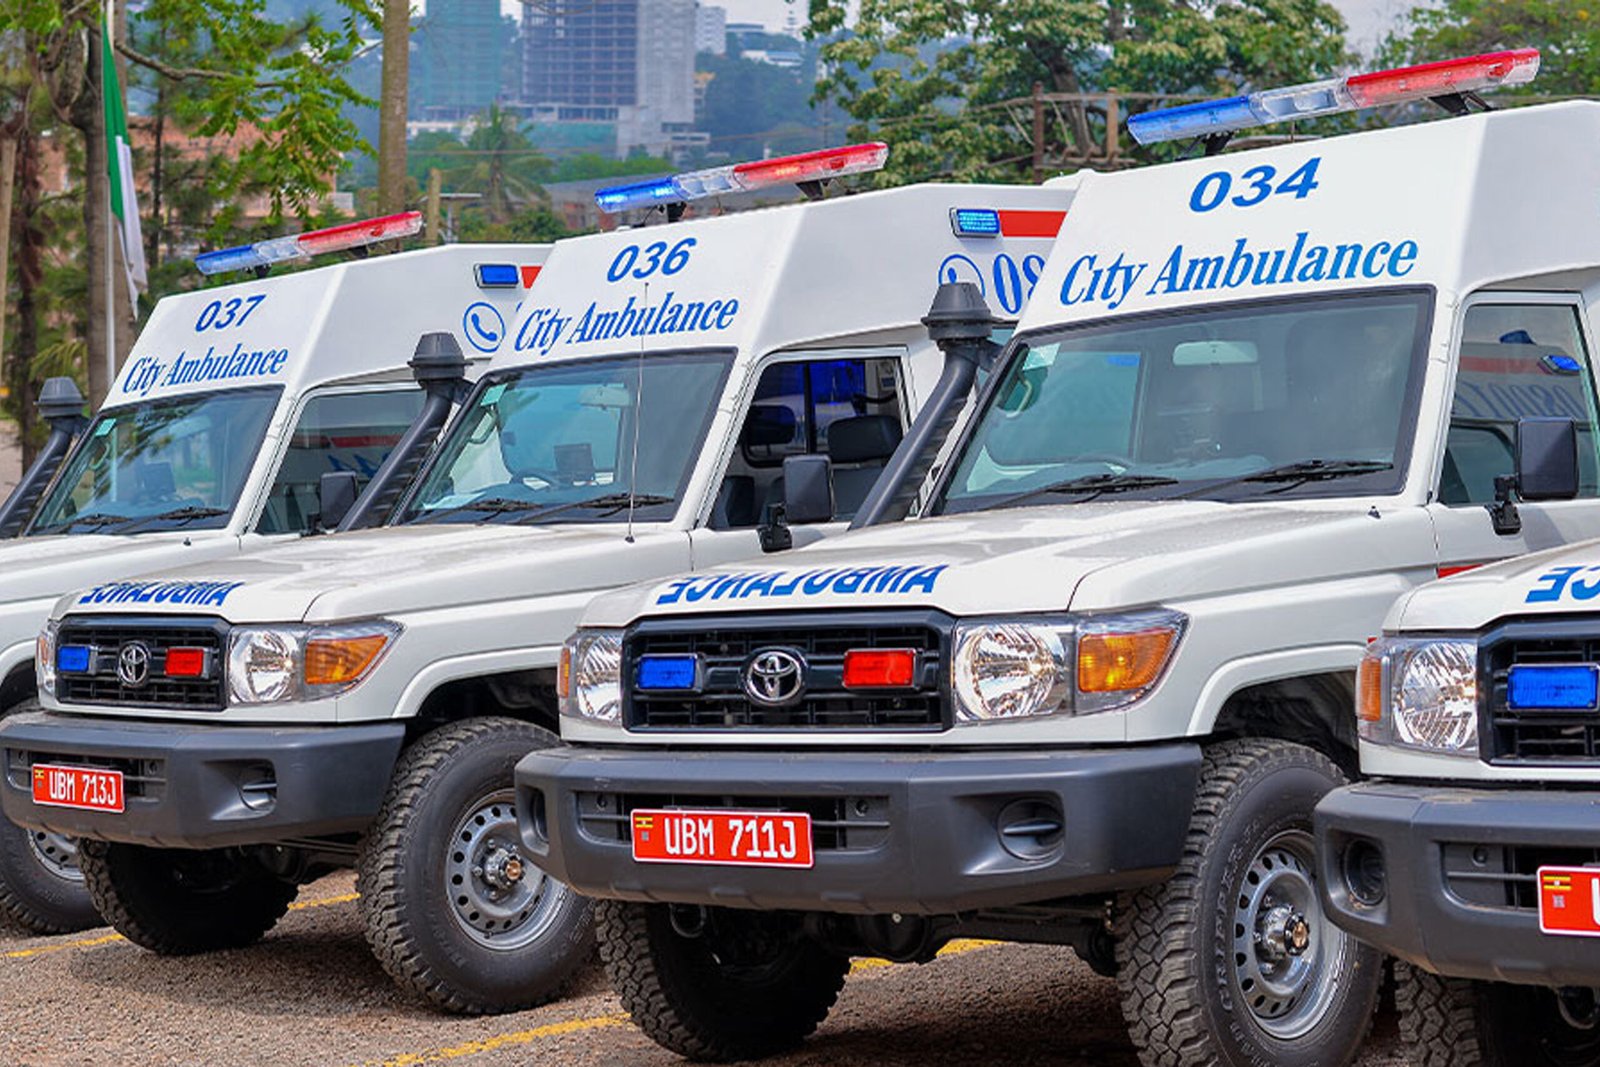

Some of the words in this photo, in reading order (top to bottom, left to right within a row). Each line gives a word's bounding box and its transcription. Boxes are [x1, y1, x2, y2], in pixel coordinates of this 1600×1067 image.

[1189, 157, 1322, 214] 034
[606, 237, 697, 282] 036
[1146, 232, 1418, 297] Ambulance
[195, 294, 266, 333] 037
[513, 307, 565, 357] City
[566, 292, 739, 345] Ambulance
[122, 356, 163, 397] City
[160, 343, 289, 388] Ambulance
[49, 771, 76, 801] UBM
[82, 774, 117, 806] 713J
[664, 817, 715, 855] UBM
[729, 819, 797, 859] 711J
